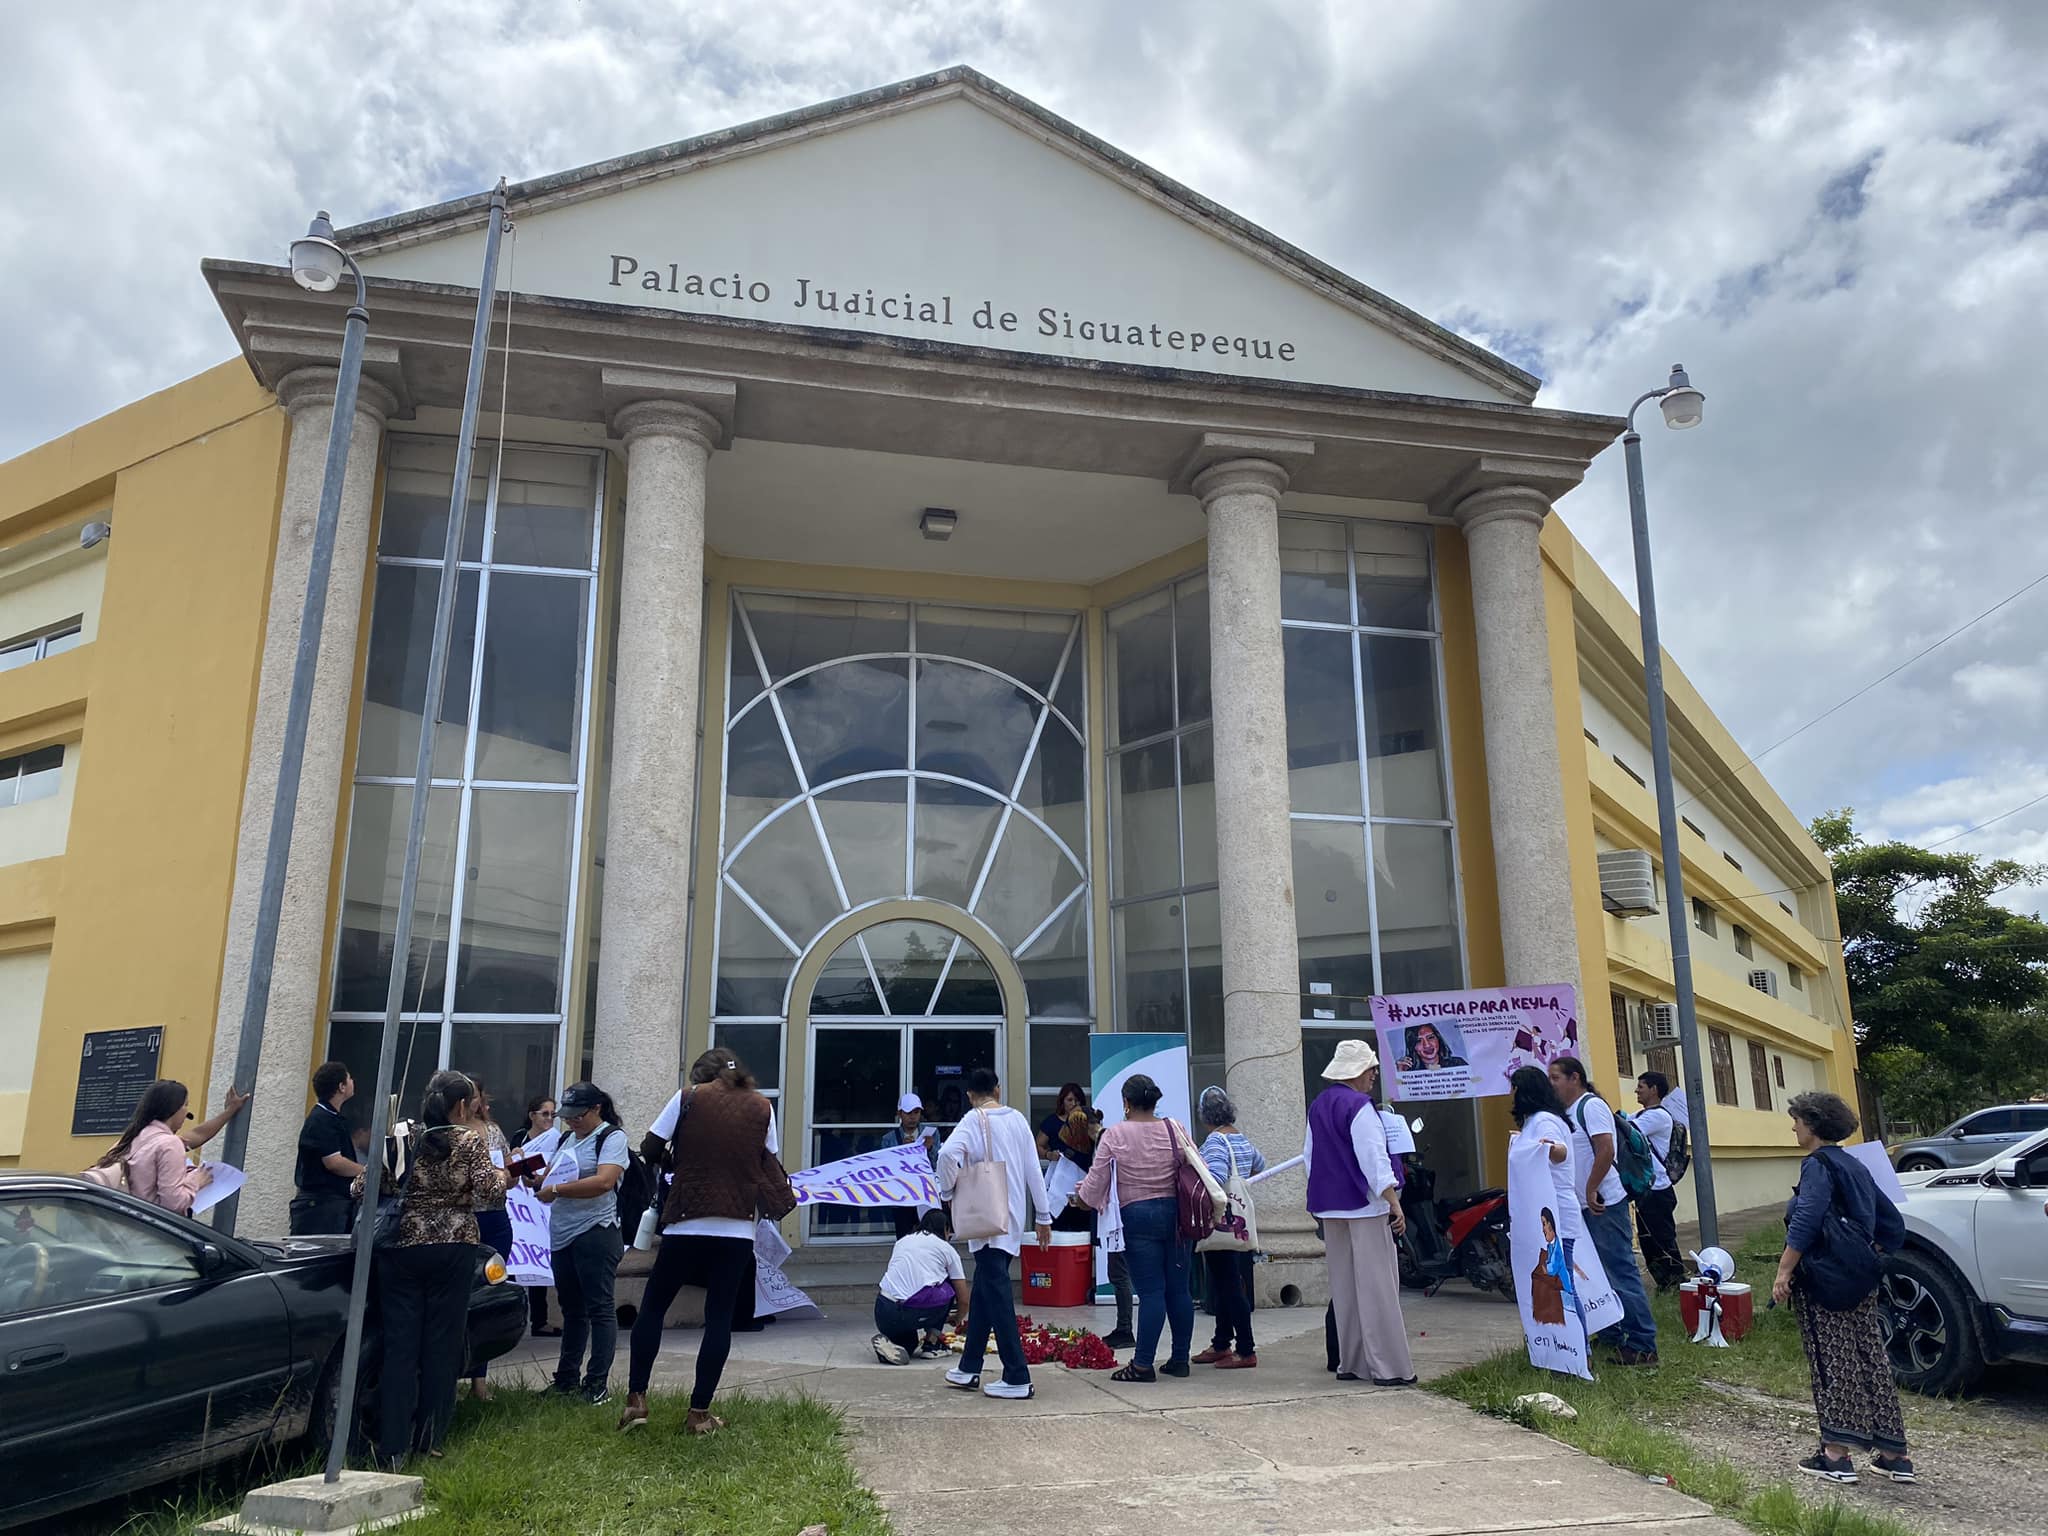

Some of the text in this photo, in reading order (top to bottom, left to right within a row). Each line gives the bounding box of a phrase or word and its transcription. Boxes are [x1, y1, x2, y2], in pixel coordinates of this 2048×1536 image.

[608, 254, 1296, 362] Palacio Judicial de Siguatepeque
[1387, 996, 1560, 1022] #JUSTICIA PARA KEYLA
[1533, 1336, 1550, 1348] en
